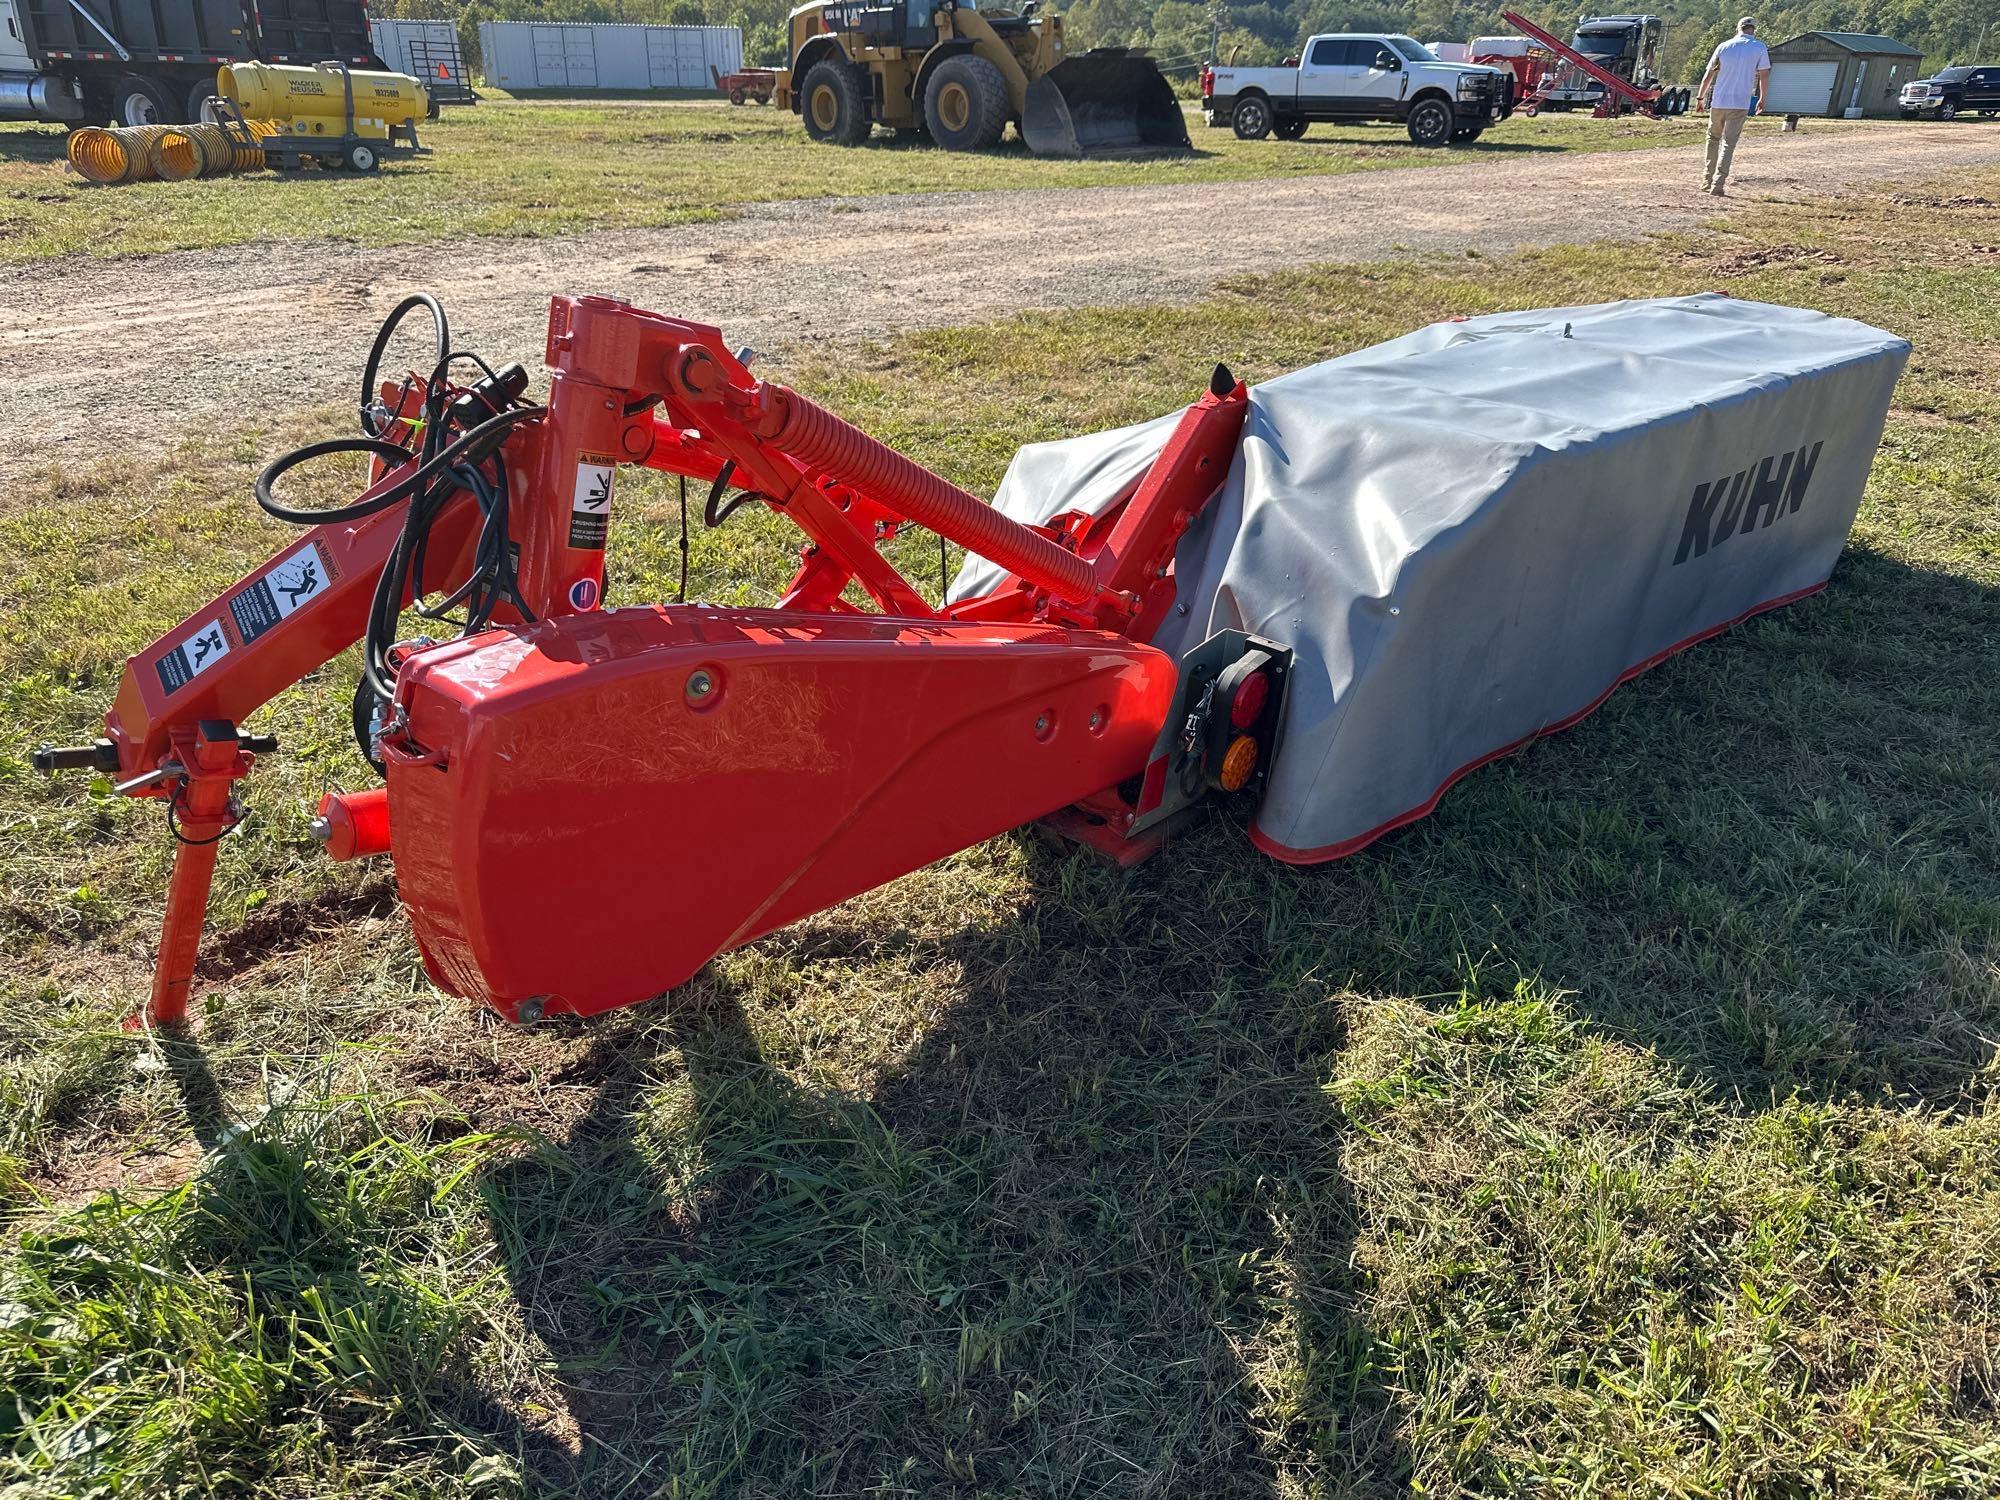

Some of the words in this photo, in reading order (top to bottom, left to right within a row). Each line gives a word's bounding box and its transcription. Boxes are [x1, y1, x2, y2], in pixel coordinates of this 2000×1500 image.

[290, 86, 324, 94] NEUSON
[1672, 440, 1824, 566] KUHN
[320, 545, 340, 581] WARNING
[258, 582, 270, 604] ROTATING
[267, 603, 277, 620] TOOLS
